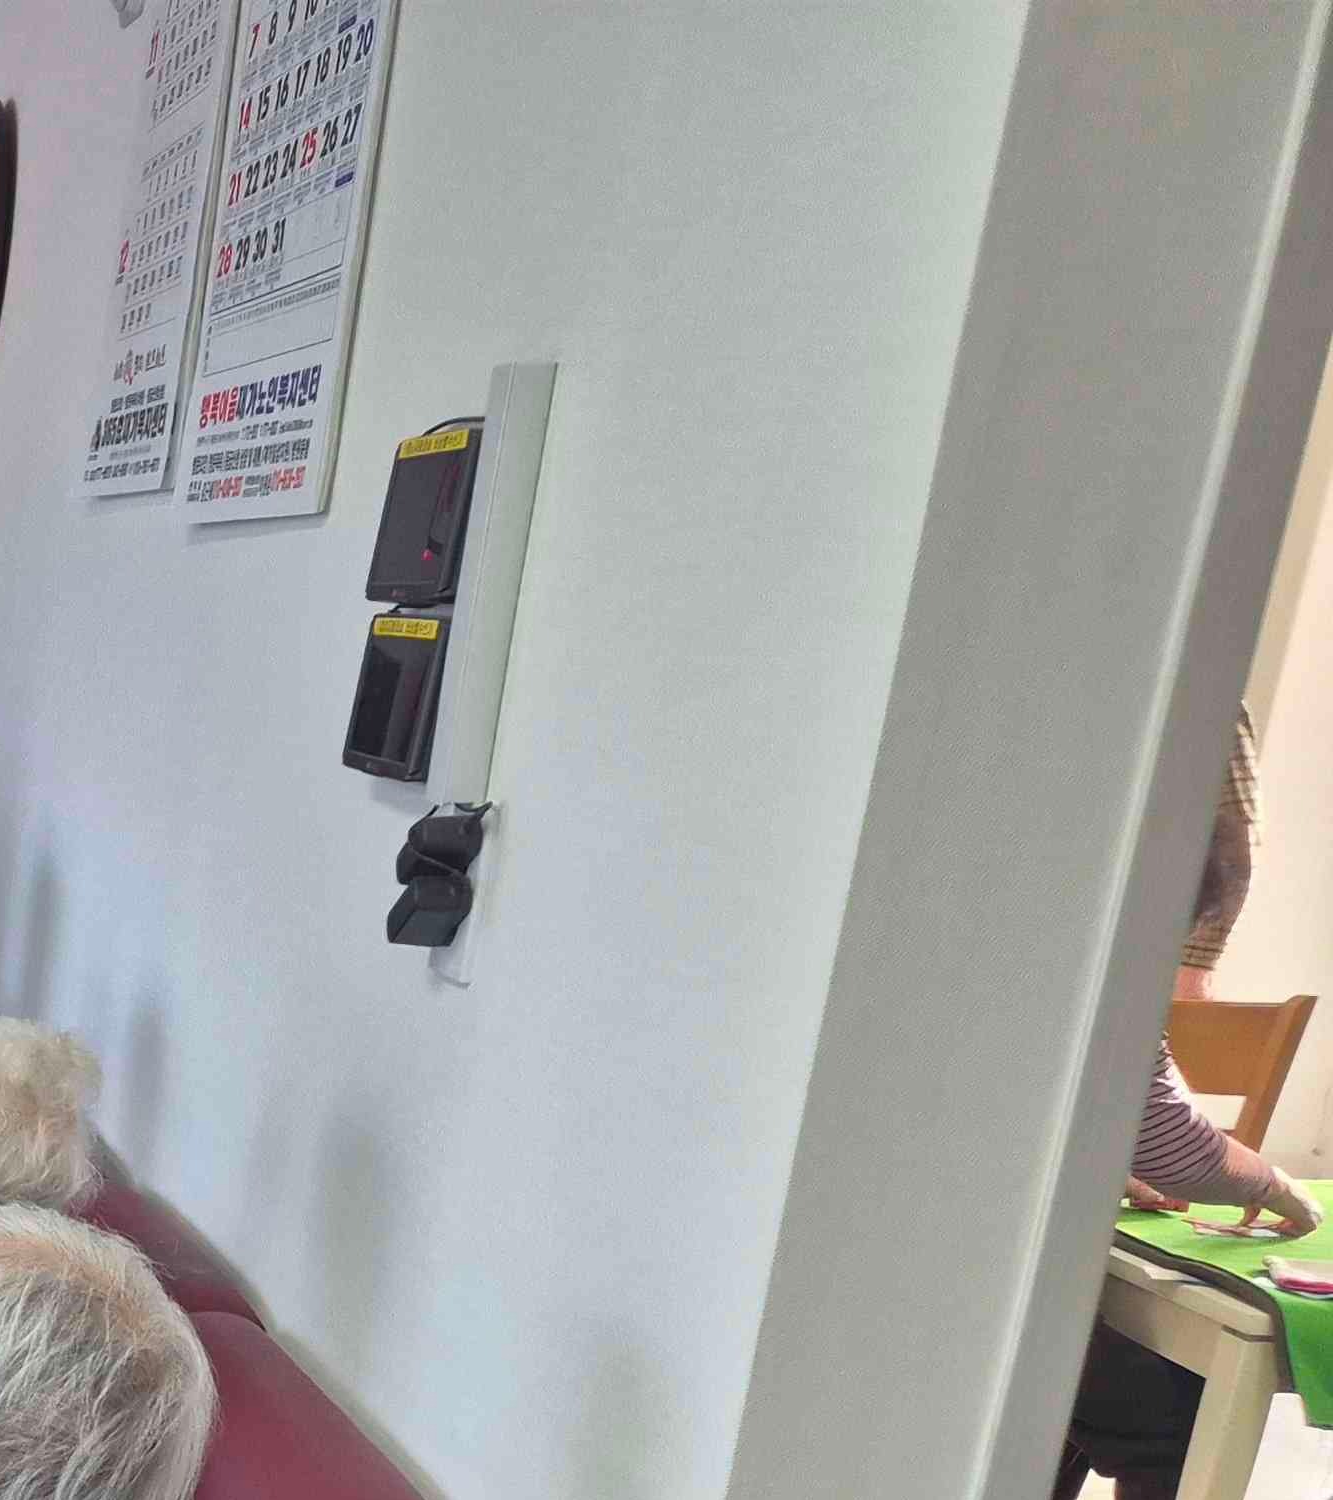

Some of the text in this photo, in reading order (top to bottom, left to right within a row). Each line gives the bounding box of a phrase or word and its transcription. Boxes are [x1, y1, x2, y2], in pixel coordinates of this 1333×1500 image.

[248, 23, 261, 59] 7
[268, 11, 278, 45] 8
[287, 0, 297, 33] 9
[238, 18, 375, 134] 14 15 16 17 18 19 20
[228, 103, 364, 206] 21 22 23 24 25 26 27
[216, 216, 287, 279] 28 29 30 31
